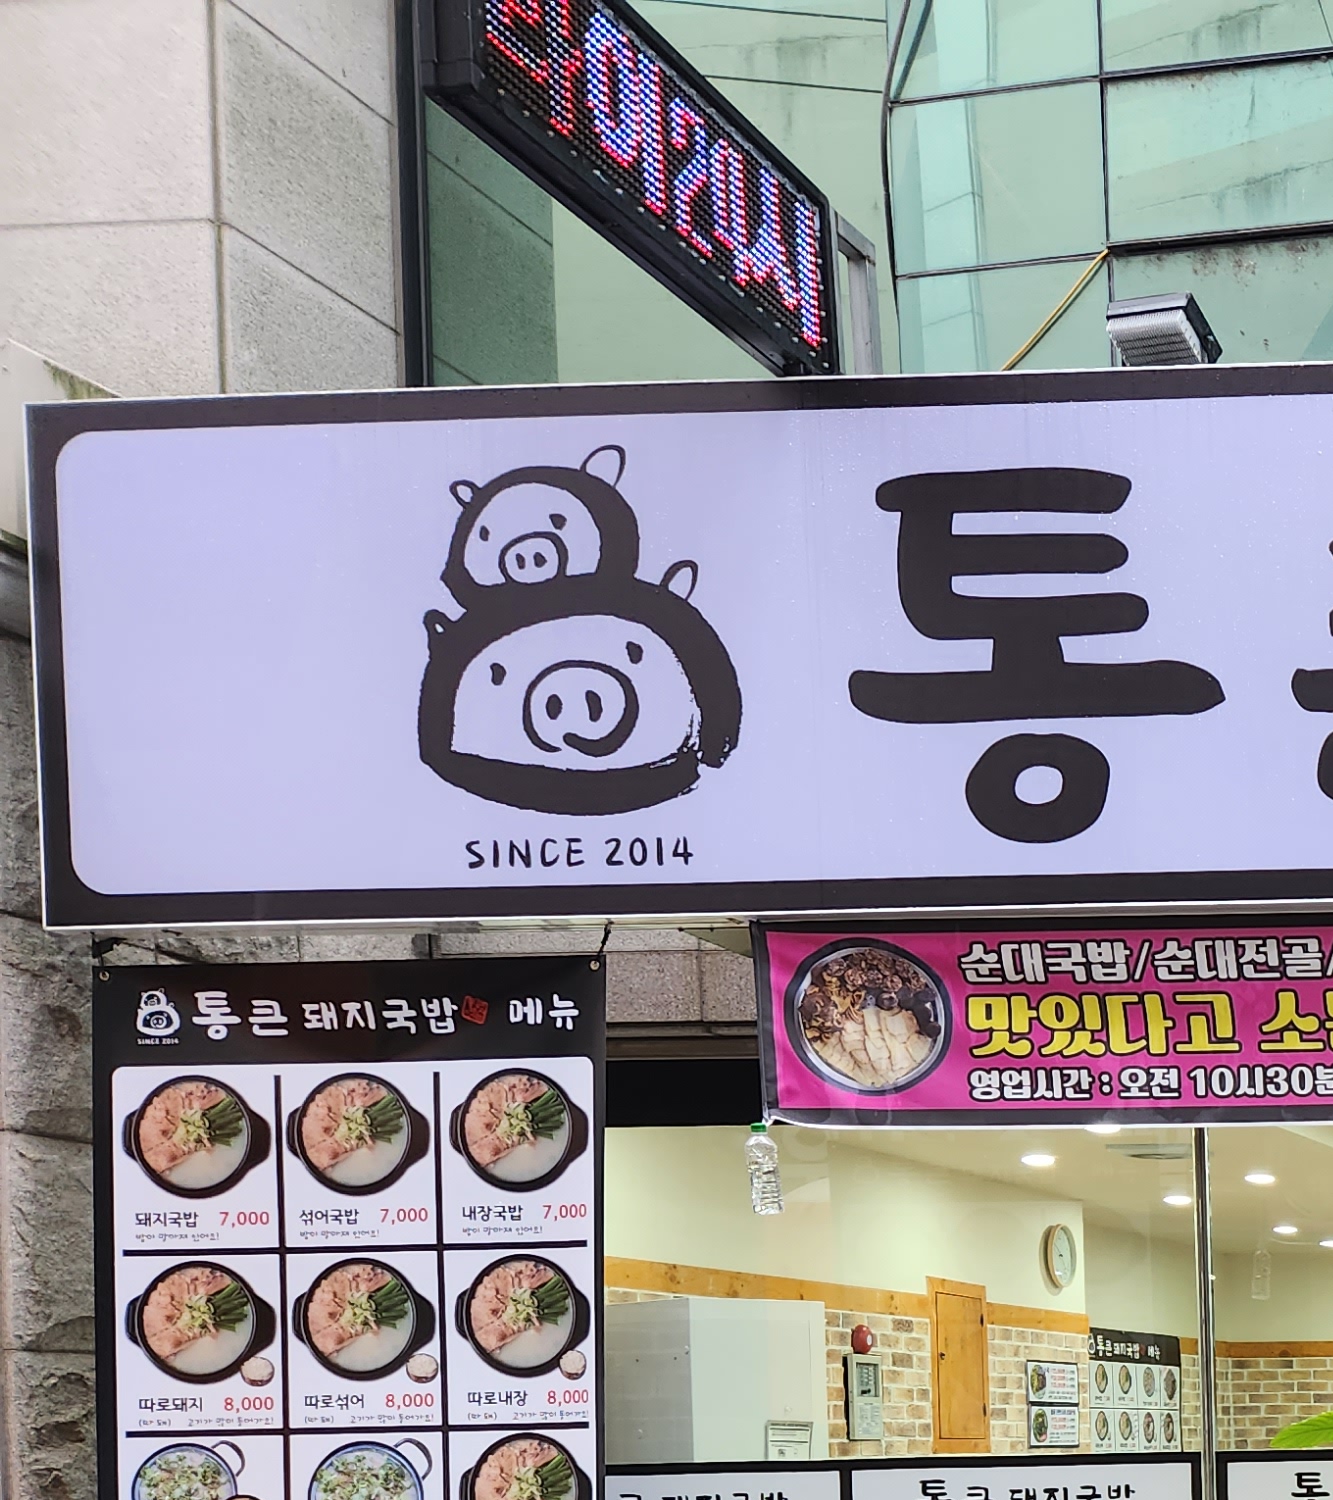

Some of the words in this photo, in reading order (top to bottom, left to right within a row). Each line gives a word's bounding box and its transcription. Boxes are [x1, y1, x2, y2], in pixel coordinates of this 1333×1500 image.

[465, 839, 586, 869] SINCE
[604, 837, 694, 867] 2014
[191, 991, 289, 1040] 통큰
[302, 997, 457, 1034] 돼지국밥
[509, 994, 579, 1030] 메뉴
[966, 990, 1242, 1058] 맛있다고
[968, 1066, 1095, 1100] 영업시간
[1119, 1063, 1181, 1098] 오전
[135, 1211, 198, 1228] 돼지국밥
[219, 1211, 270, 1228] 7,000
[299, 1208, 359, 1226] 섞어국밥
[380, 1208, 428, 1225] 7,000
[462, 1205, 523, 1222] 내장국밥
[542, 1204, 587, 1222] 7,000
[139, 1397, 203, 1412] 따로돼지
[223, 1397, 274, 1413] 8,000
[304, 1394, 365, 1410] 따로섞어
[385, 1393, 434, 1410] 8,000
[467, 1390, 528, 1407] 따로내장
[547, 1390, 589, 1407] 8,000
